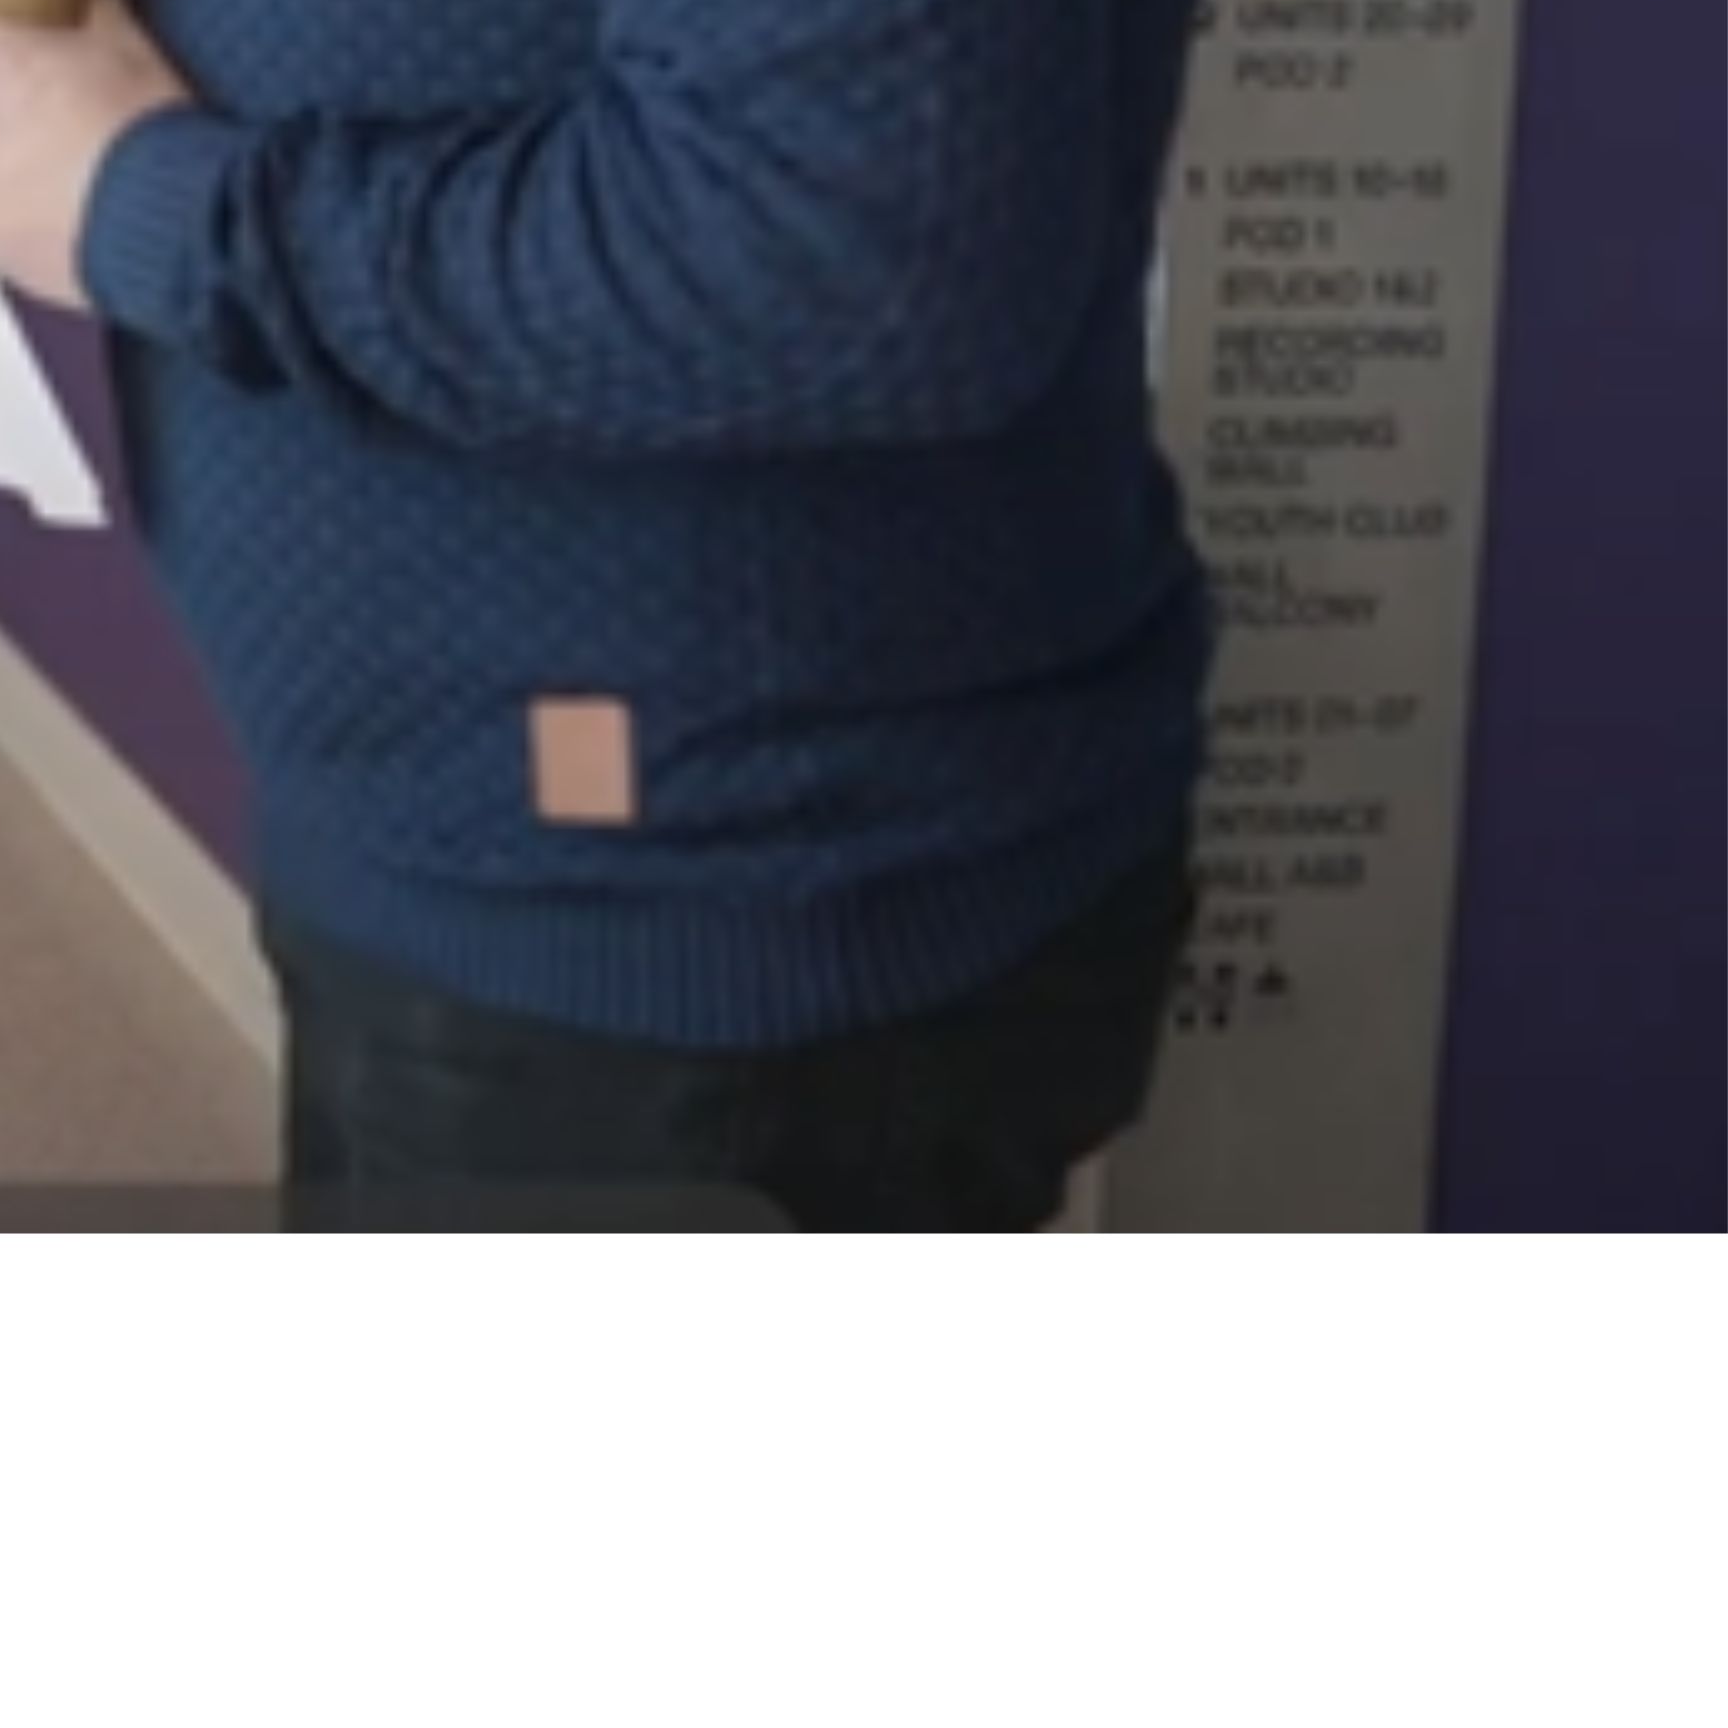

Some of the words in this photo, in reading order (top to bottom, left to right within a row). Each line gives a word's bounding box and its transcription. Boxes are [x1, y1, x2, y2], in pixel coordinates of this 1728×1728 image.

[1234, 52, 1318, 90] POD
[1224, 158, 1336, 198] UNITS
[1223, 218, 1305, 255] POD
[1220, 268, 1364, 308] STUDIO
[1214, 327, 1446, 360] RECORDING
[1213, 365, 1356, 396] STUDIO
[1206, 416, 1398, 450] CLIMBING
[1200, 506, 1336, 537] YOUTH
[1346, 505, 1447, 538] CLUB
[1204, 804, 1388, 835] NTRANCE
